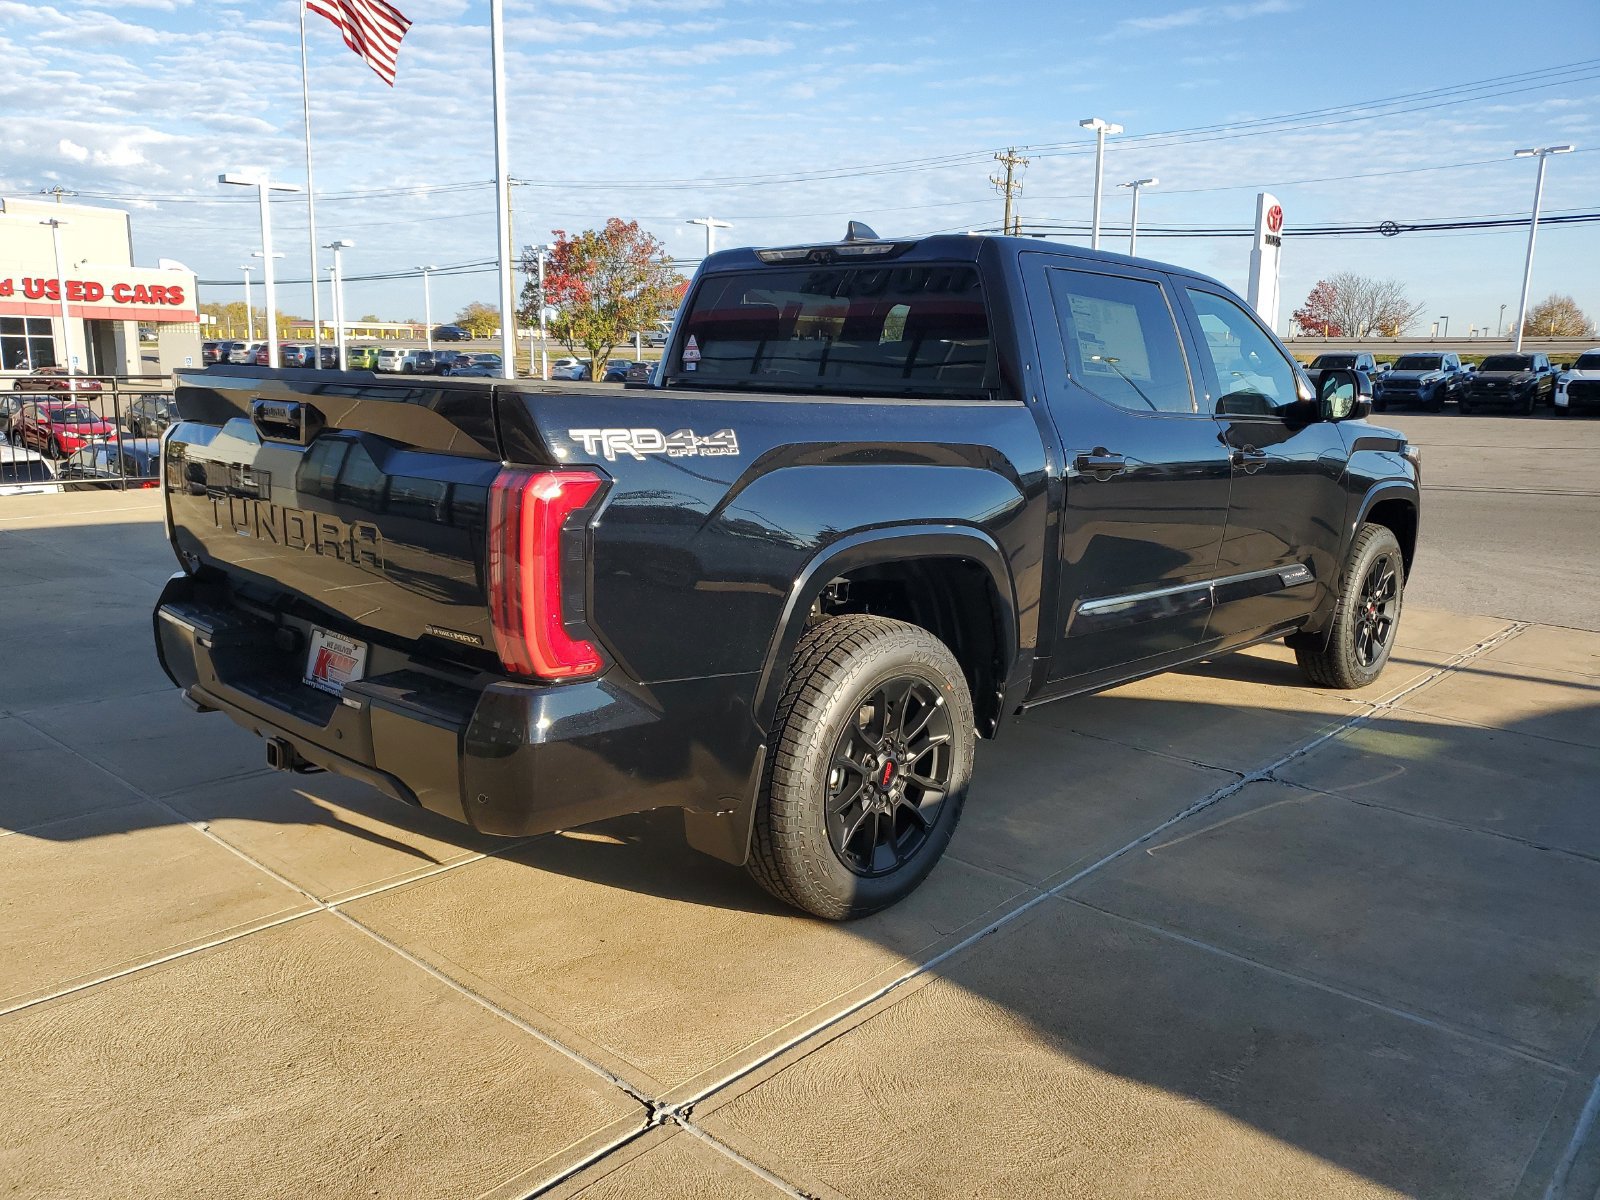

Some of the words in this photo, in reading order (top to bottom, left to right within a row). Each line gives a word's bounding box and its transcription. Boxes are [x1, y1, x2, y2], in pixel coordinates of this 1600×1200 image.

[22, 277, 104, 302] USED
[112, 282, 185, 305] CARS
[568, 428, 667, 461] TRD
[665, 428, 739, 449] 4x4
[667, 447, 697, 457] OFF
[700, 447, 739, 456] ROAD
[206, 488, 385, 569] TUNDRA
[454, 632, 480, 644] MAX
[882, 761, 892, 786] TRD
